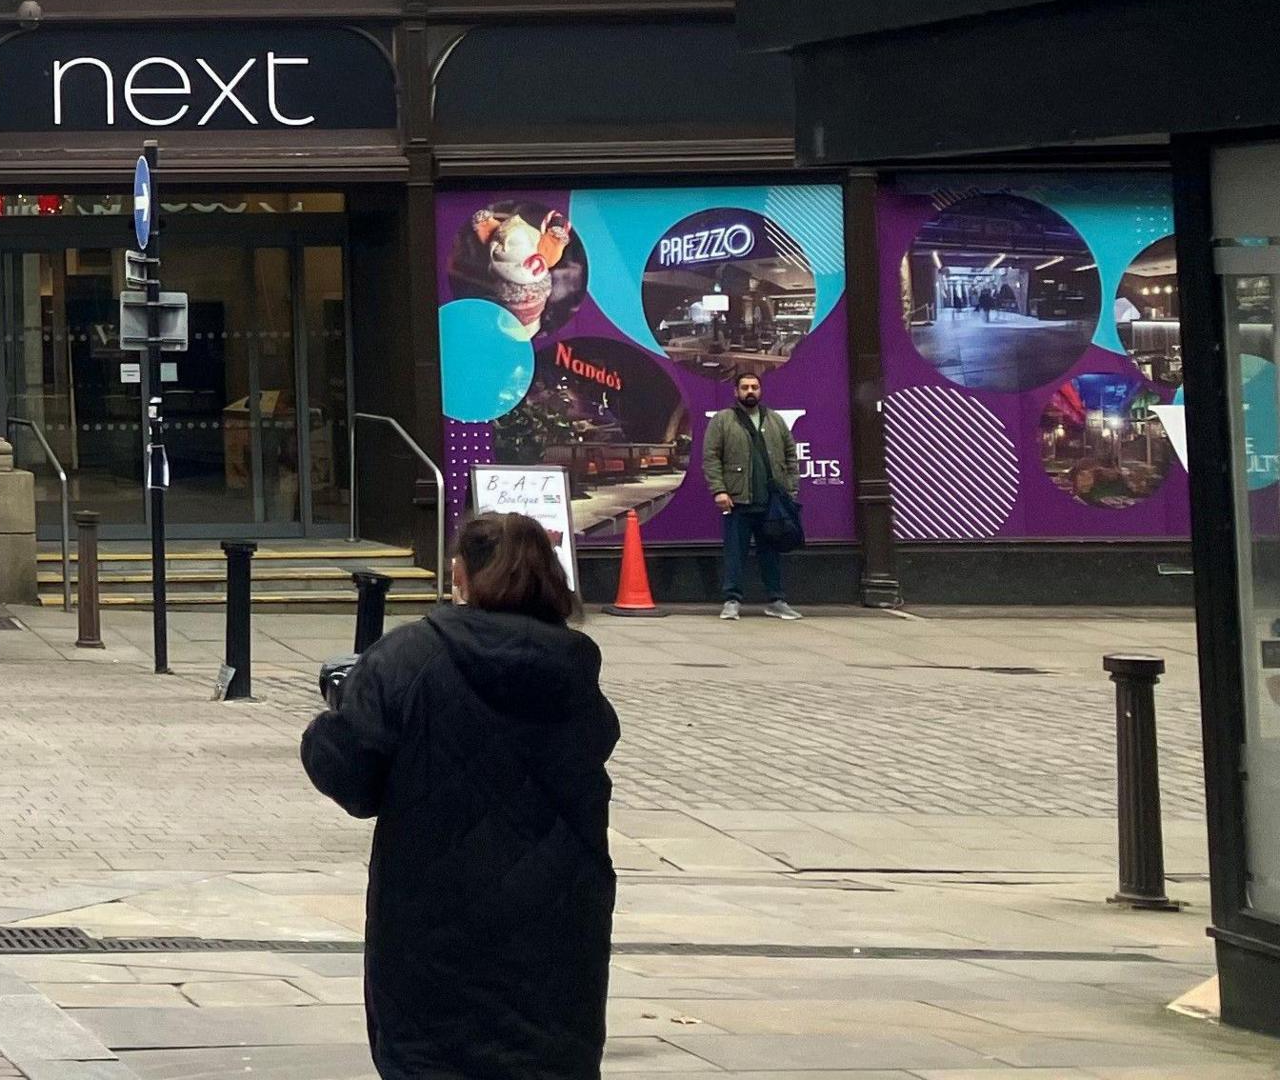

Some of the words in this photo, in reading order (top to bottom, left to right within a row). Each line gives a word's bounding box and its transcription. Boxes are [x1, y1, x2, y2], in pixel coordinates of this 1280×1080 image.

[53, 51, 316, 126] next
[659, 223, 755, 267] PREZZO
[555, 341, 623, 392] Nando's
[799, 459, 841, 478] ULTS
